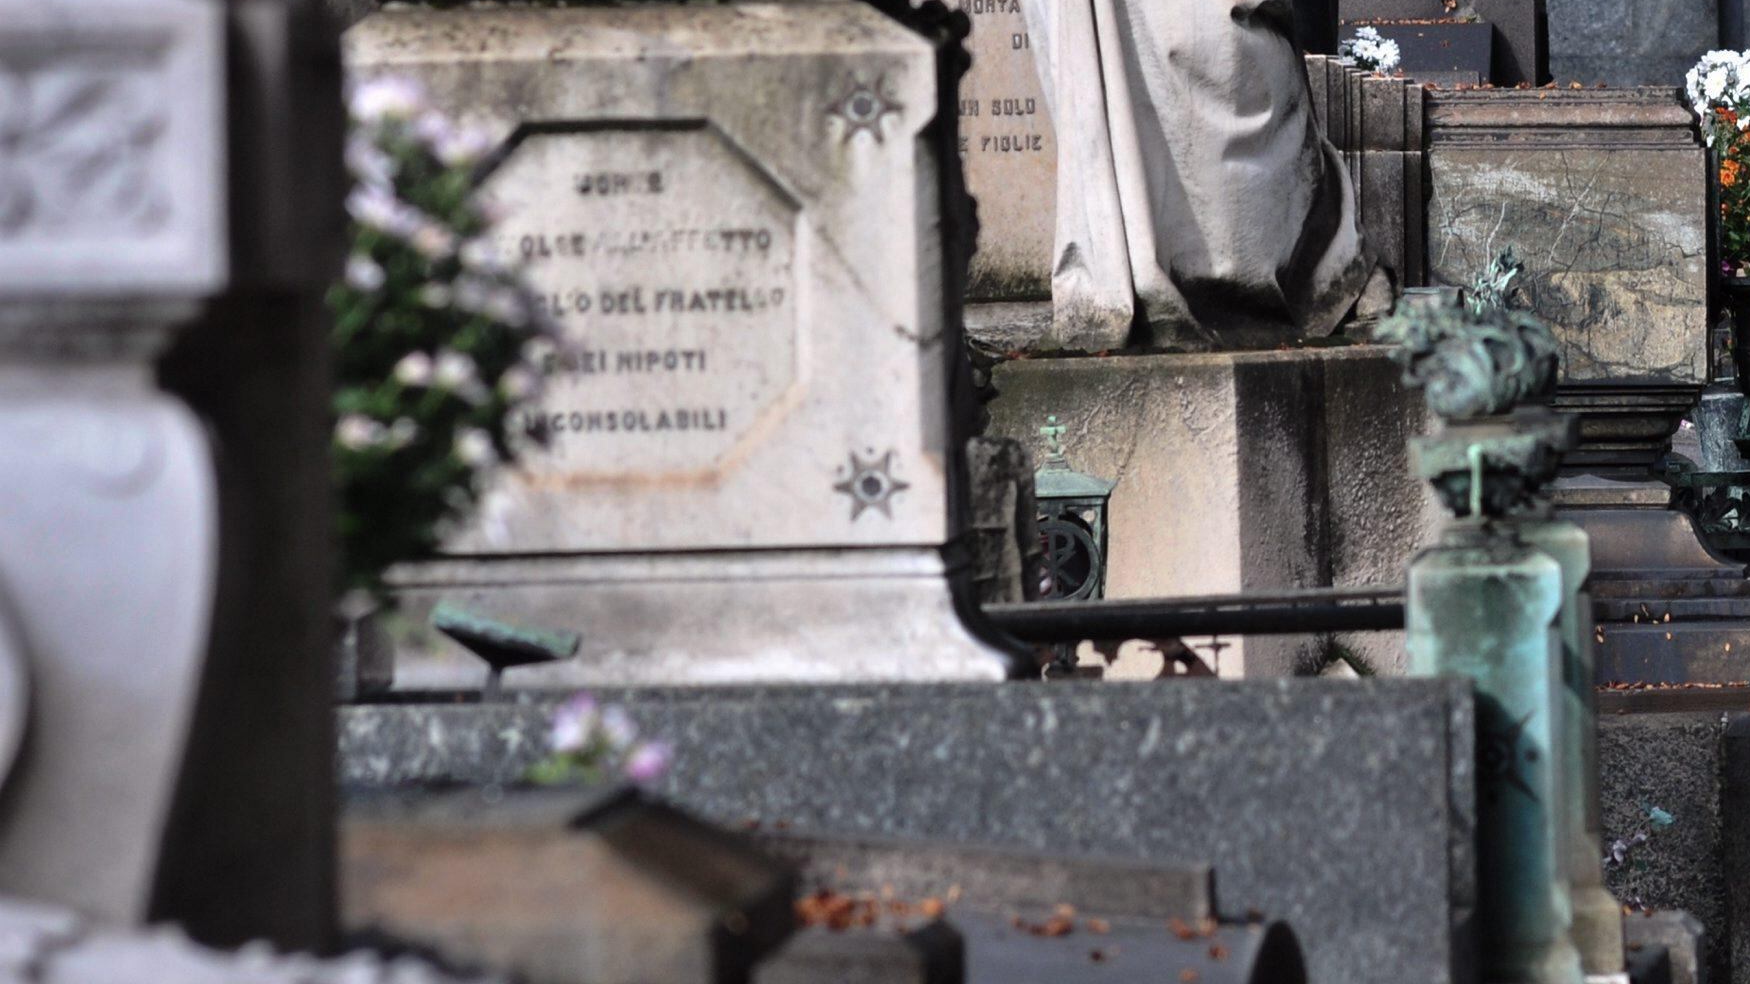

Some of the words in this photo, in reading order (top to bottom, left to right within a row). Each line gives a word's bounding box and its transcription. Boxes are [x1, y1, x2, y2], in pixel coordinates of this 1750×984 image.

[1012, 33, 1029, 50] DI
[991, 98, 1035, 116] SOLO
[981, 135, 1042, 152] FIGLIE
[600, 286, 645, 313] DEL
[616, 349, 706, 371] NIPOTI
